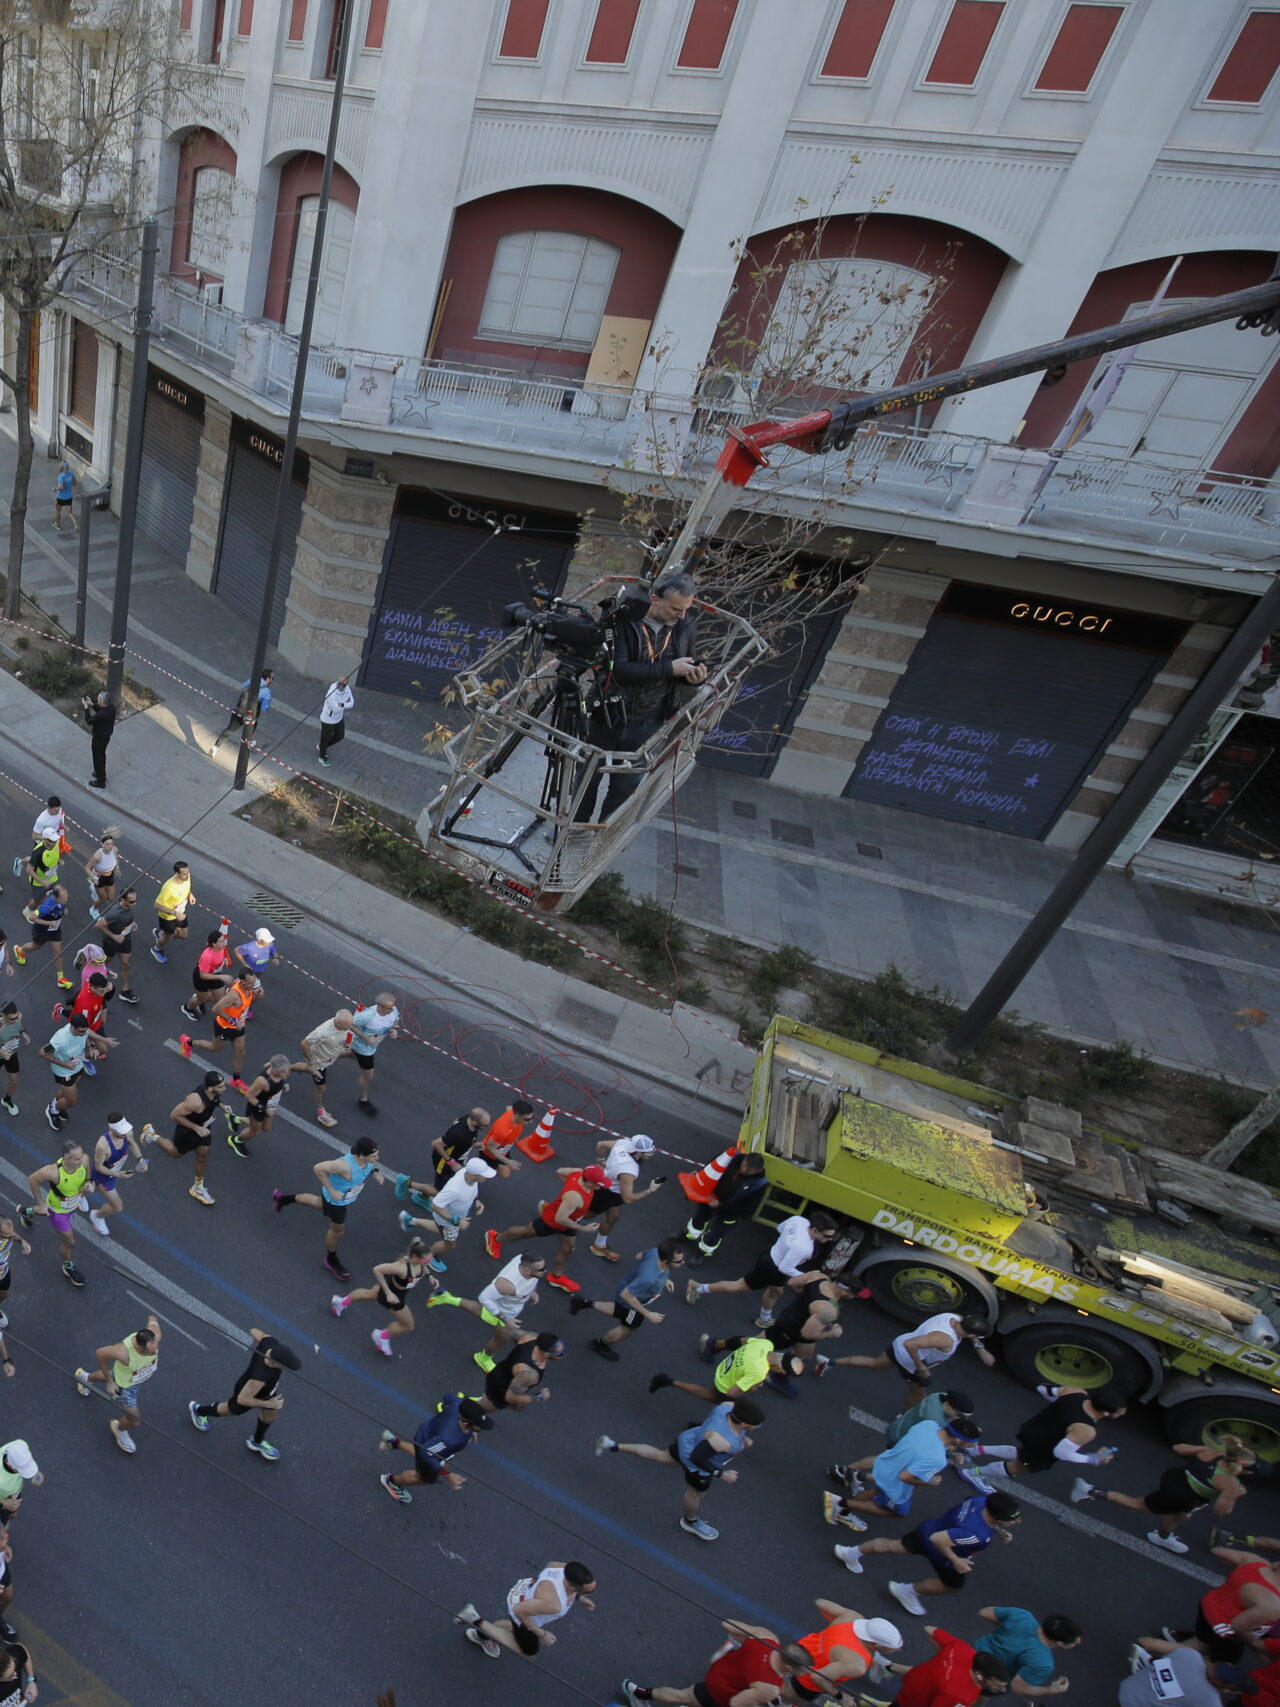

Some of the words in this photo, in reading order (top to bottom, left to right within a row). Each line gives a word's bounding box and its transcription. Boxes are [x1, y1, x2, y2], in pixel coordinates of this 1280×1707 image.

[157, 380, 187, 405] GUCCI
[250, 435, 284, 463] GUCC
[448, 503, 526, 530] GUCCI
[1011, 603, 1112, 633] GUCCI
[871, 1209, 1080, 1301] DARDOUMAS
[883, 1204, 956, 1239] TRANSPORT
[964, 1236, 1022, 1262] BASKETS
[1032, 1262, 1085, 1287] CRANES
